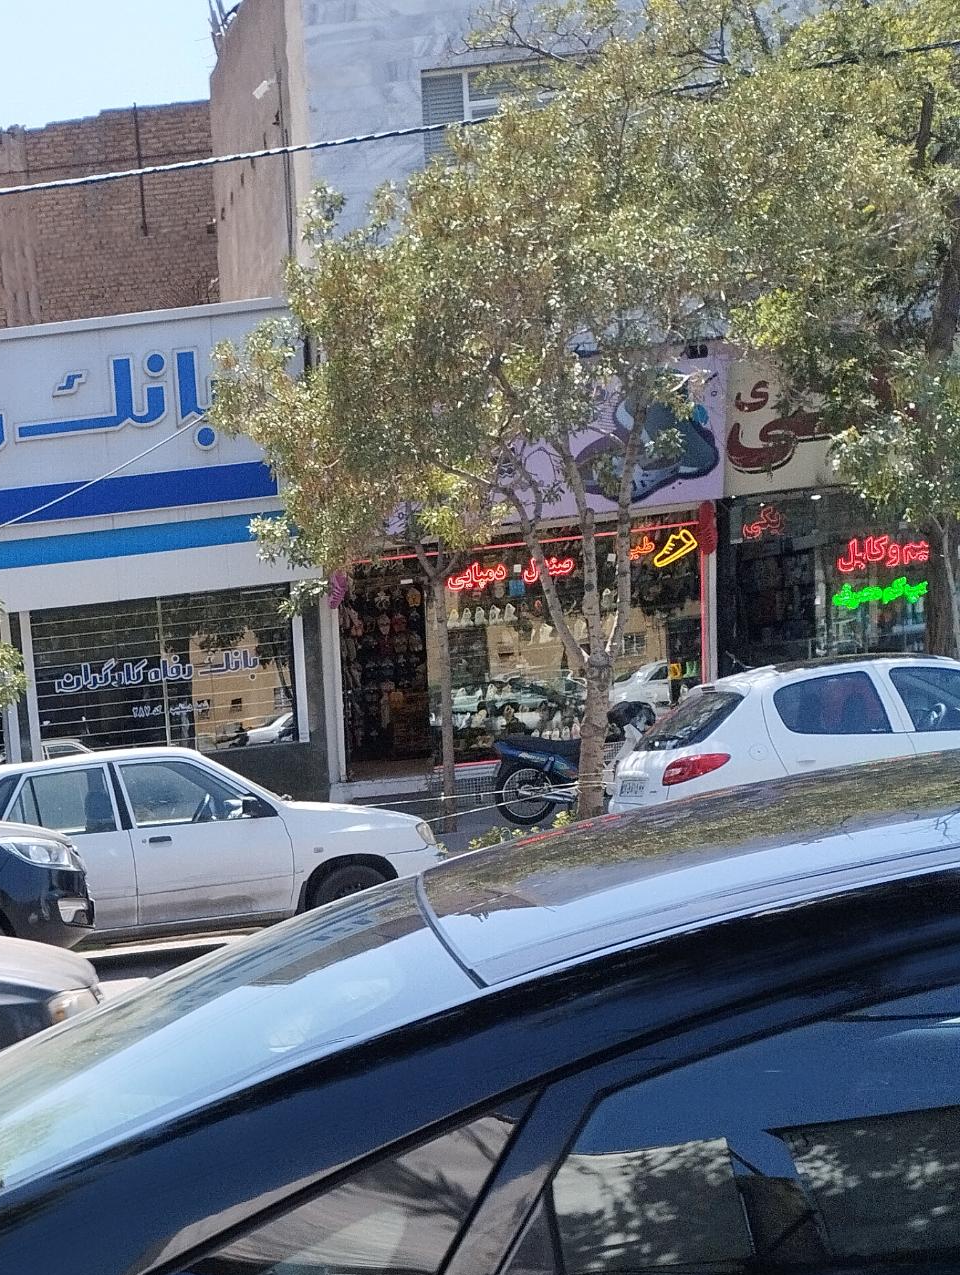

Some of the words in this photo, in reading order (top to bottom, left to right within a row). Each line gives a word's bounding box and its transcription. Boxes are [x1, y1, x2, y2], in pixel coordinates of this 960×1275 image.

[838, 535, 889, 572] کابل
[447, 561, 508, 591] دمپایی
[54, 658, 148, 694] کارگران
[147, 654, 194, 684] رفاه
[198, 649, 260, 681] بانک
